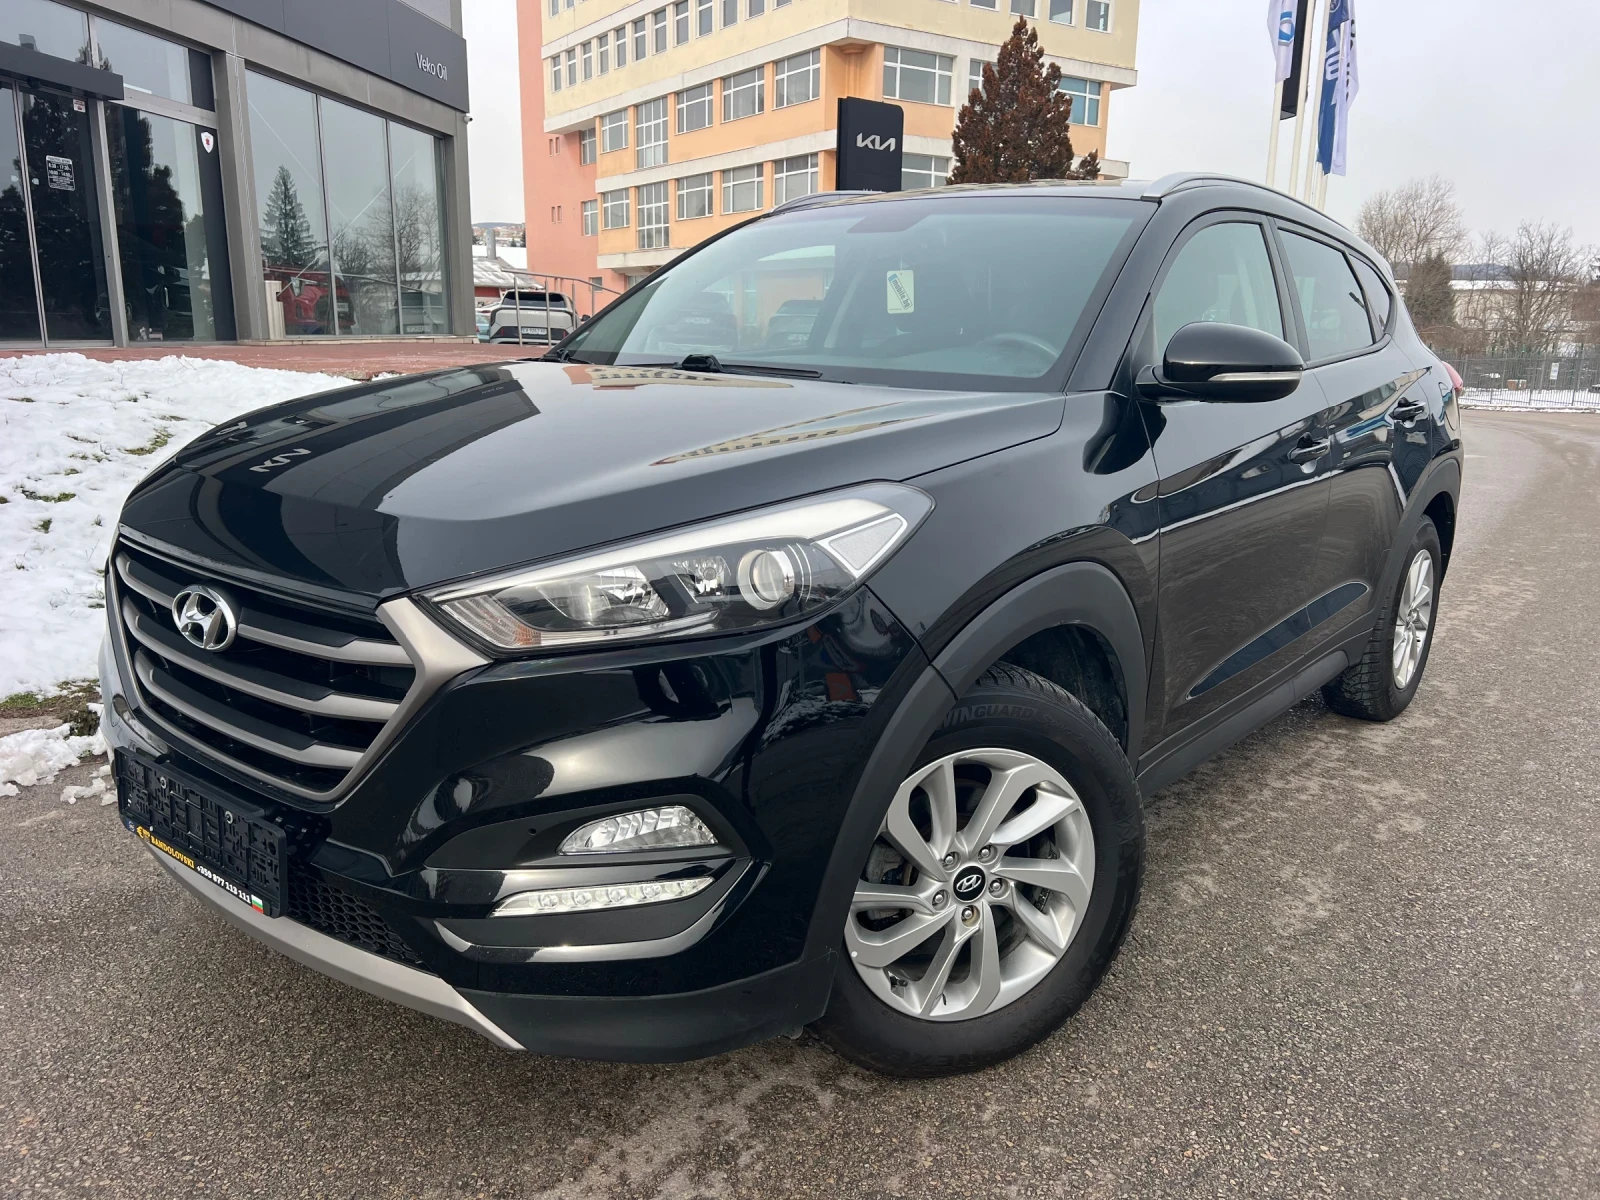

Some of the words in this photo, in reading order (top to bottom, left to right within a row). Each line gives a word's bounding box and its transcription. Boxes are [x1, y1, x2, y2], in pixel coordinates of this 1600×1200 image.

[416, 52, 436, 75] Veko
[437, 63, 447, 81] Oil
[856, 132, 896, 152] KIA
[892, 279, 911, 308] mobile.bg
